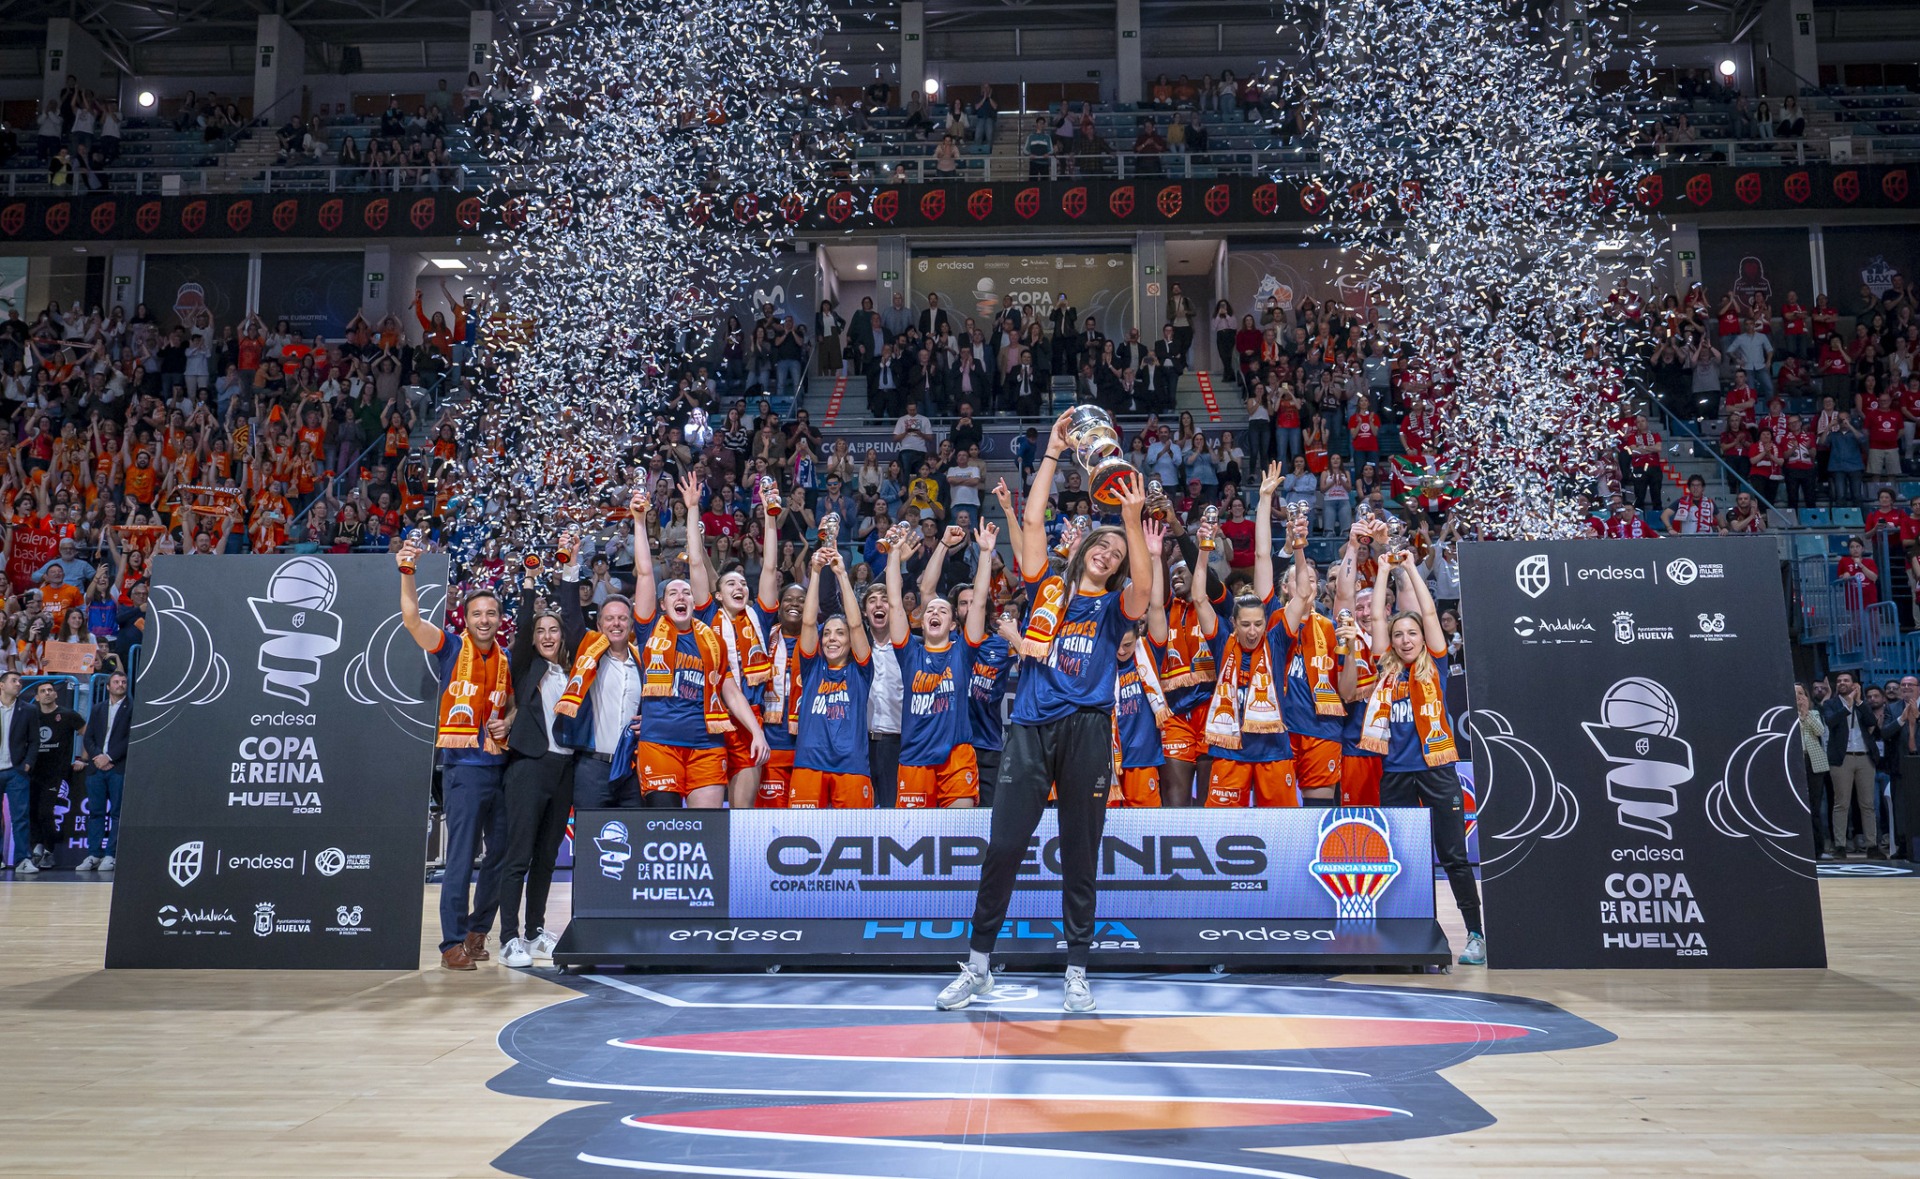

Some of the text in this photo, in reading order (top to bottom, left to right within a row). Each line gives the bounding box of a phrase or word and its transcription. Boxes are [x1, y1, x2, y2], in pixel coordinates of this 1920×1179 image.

[936, 260, 974, 270] endesa
[1009, 275, 1049, 285] endesa
[821, 442, 857, 453] COA
[1577, 565, 1646, 580] endesa
[1538, 617, 1597, 632] Andalucía
[1637, 632, 1675, 640] HUELVA
[1062, 635, 1093, 654] REINA
[1057, 654, 1081, 677] 2024
[250, 710, 317, 726] endesa
[239, 736, 319, 760] COPA
[230, 762, 324, 783] DE LA REINA
[649, 778, 675, 787] PULEVA
[228, 792, 322, 806] HUELVA
[899, 795, 925, 803] PULEVA
[1211, 789, 1238, 798] PULEVA
[75, 815, 86, 823] DE
[646, 818, 702, 831] endesa
[75, 823, 86, 831] LA
[643, 842, 708, 861] COPA
[766, 835, 1268, 876] CAMPNAS
[1611, 845, 1685, 861] endesa
[228, 853, 294, 869] endesa
[1318, 864, 1393, 872] VALENCIA BASKET
[638, 863, 714, 880] DE LA REINA
[770, 880, 807, 892] COPA
[816, 880, 856, 892] REINA
[1230, 882, 1263, 890] 2024
[1604, 873, 1694, 898] COPA
[632, 888, 714, 900] HUELVA
[181, 907, 237, 923] Andalucía
[1600, 900, 1705, 923] DE LA REINA
[275, 924, 311, 933] HUELVA
[668, 927, 803, 942] endesa
[863, 921, 1138, 939] HULA
[1198, 927, 1336, 942] endesa
[1055, 940, 1141, 950] 224
[1603, 932, 1708, 948] HUELVA
